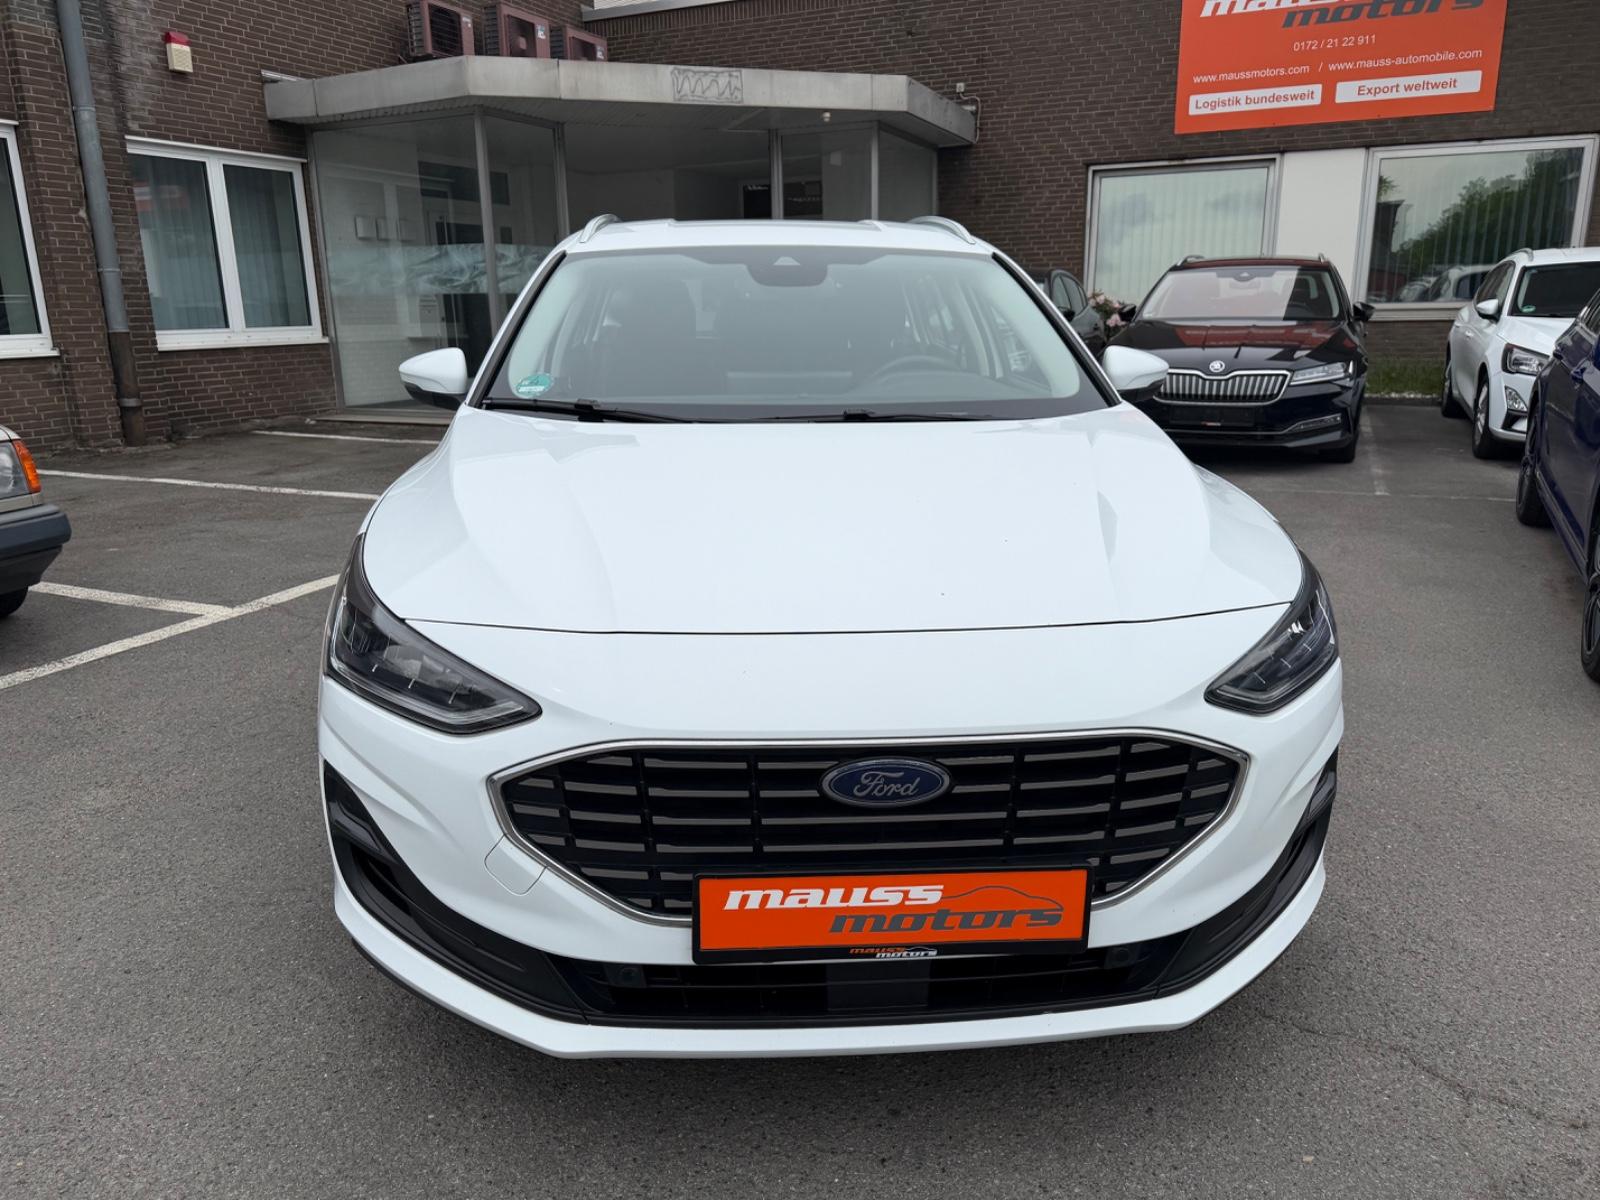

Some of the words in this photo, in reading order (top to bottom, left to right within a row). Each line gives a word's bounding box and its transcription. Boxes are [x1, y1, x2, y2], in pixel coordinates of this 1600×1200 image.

[1199, 0, 1346, 18] mau
[1293, 39, 1318, 52] 0172
[1326, 38, 1338, 49] 21
[1342, 36, 1355, 47] 22
[1357, 34, 1376, 46] 911
[1193, 64, 1310, 84] www.maussmotors.com
[1328, 49, 1483, 72] www.mauss-automobile.com
[1357, 82, 1400, 97] Export
[1403, 77, 1458, 93] weltweit
[1194, 96, 1242, 111] Logistik
[1245, 89, 1315, 106] bundesweit
[853, 771, 921, 797] Ford
[723, 884, 944, 911] mauss
[828, 907, 1063, 934] motors
[875, 950, 938, 959] motors
